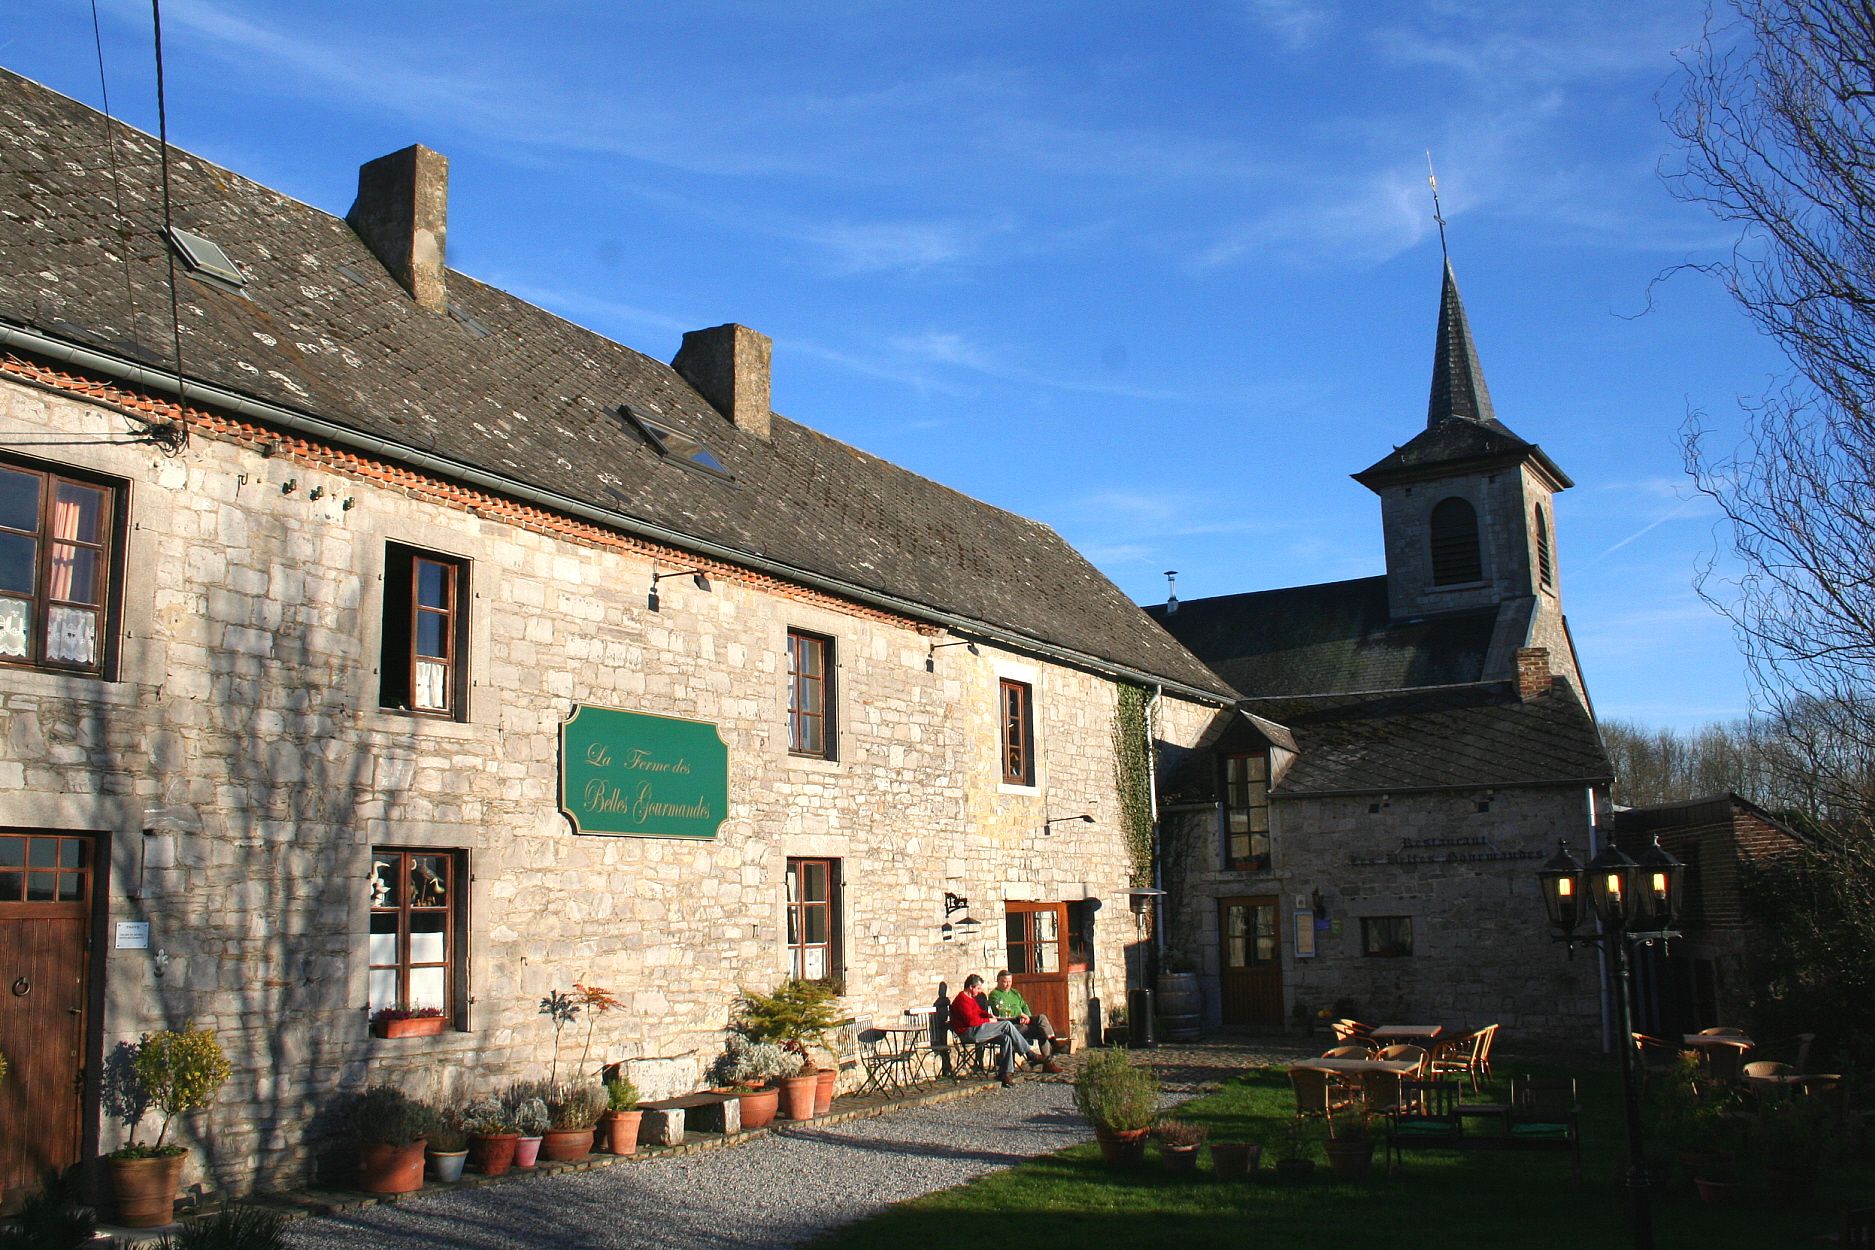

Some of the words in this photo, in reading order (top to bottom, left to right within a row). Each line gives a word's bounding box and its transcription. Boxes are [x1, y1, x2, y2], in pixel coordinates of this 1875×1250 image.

[585, 742, 612, 767] La
[624, 748, 669, 772] Ferme
[672, 758, 691, 775] des
[584, 778, 628, 814] Belles
[632, 780, 710, 824] Gourmandes
[1400, 836, 1487, 848] Restaurant
